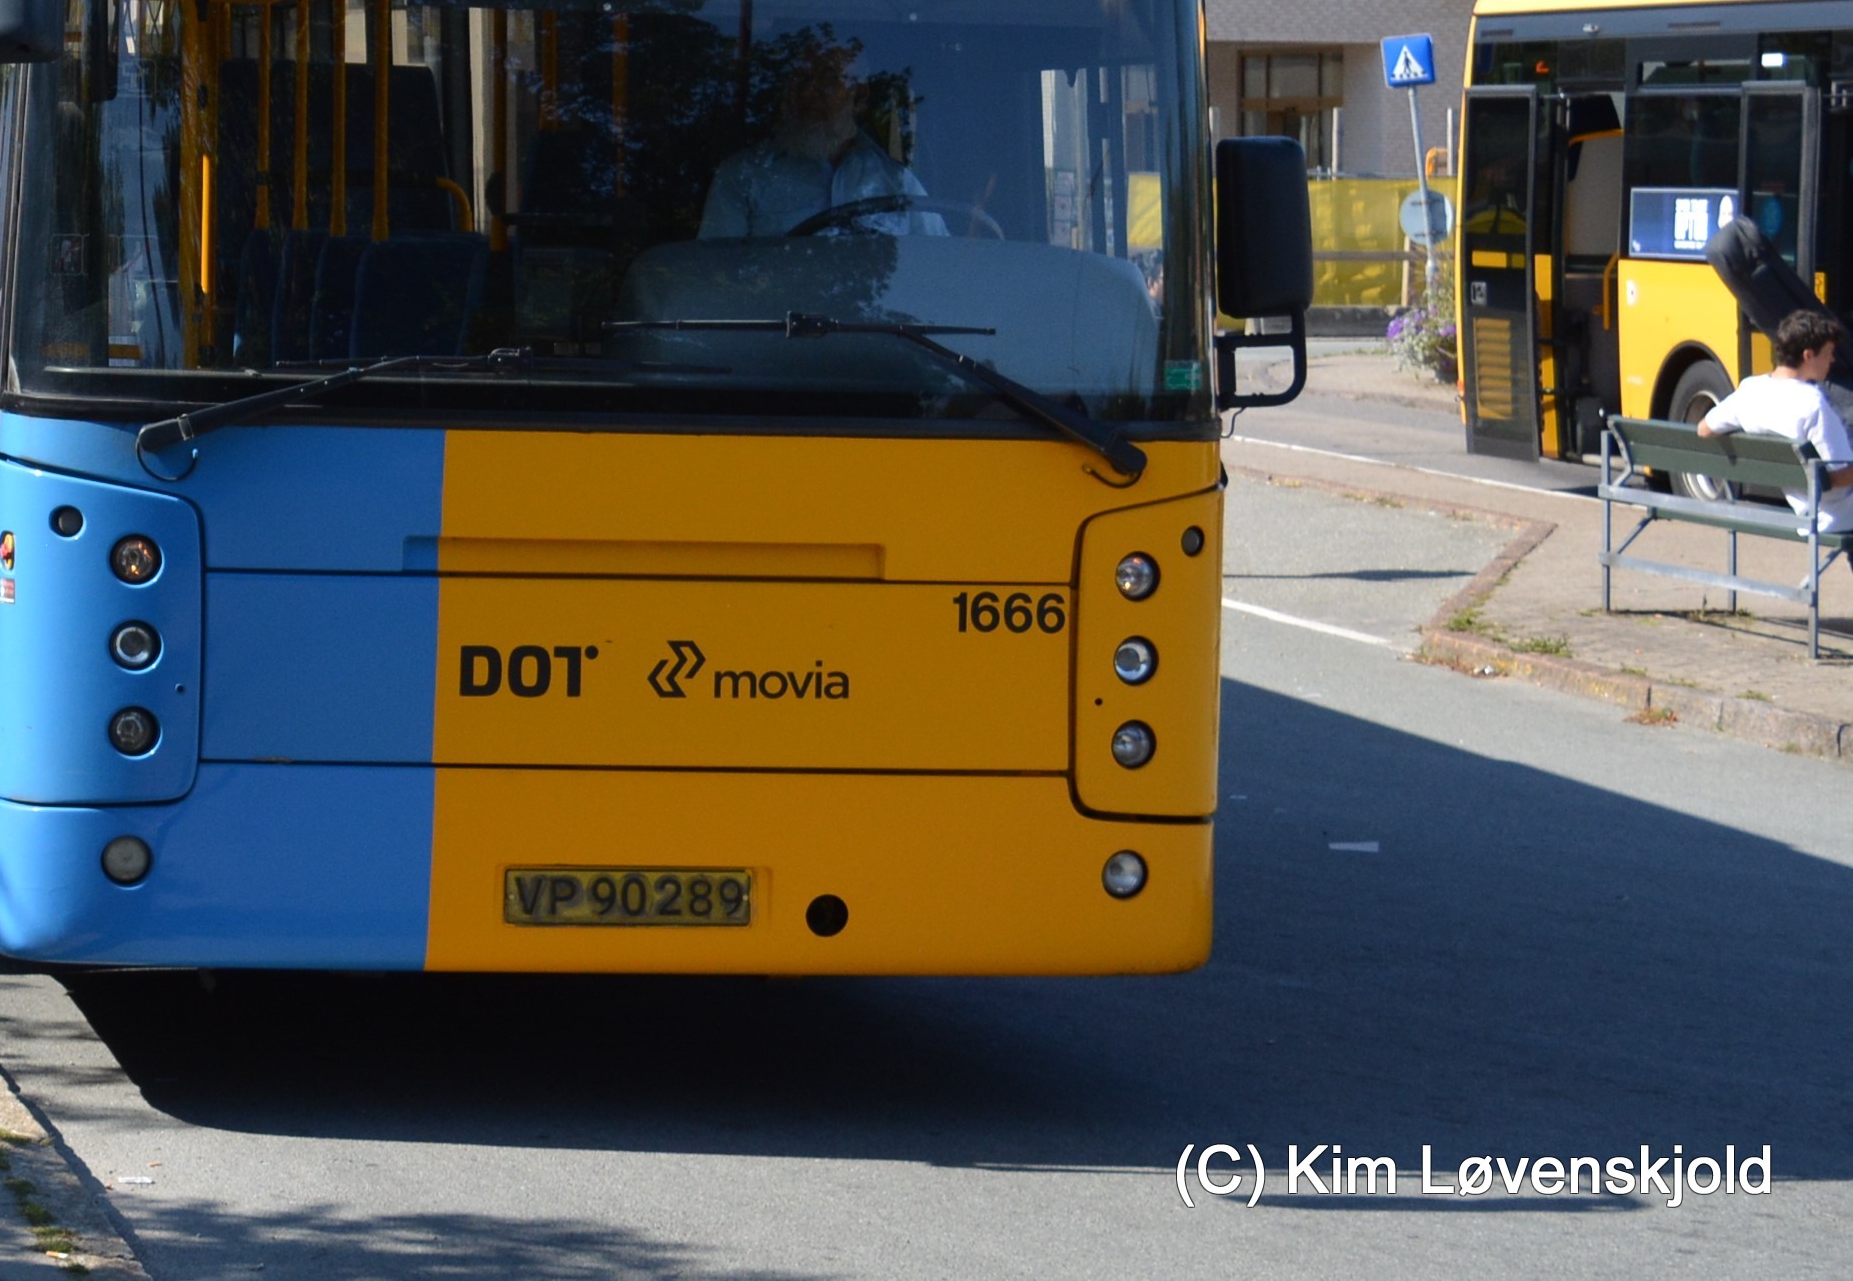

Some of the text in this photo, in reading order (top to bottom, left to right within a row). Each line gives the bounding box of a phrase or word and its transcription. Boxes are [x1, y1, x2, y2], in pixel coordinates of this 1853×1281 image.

[952, 591, 1067, 635] 1666
[459, 644, 599, 698] DOT
[712, 660, 851, 700] movia
